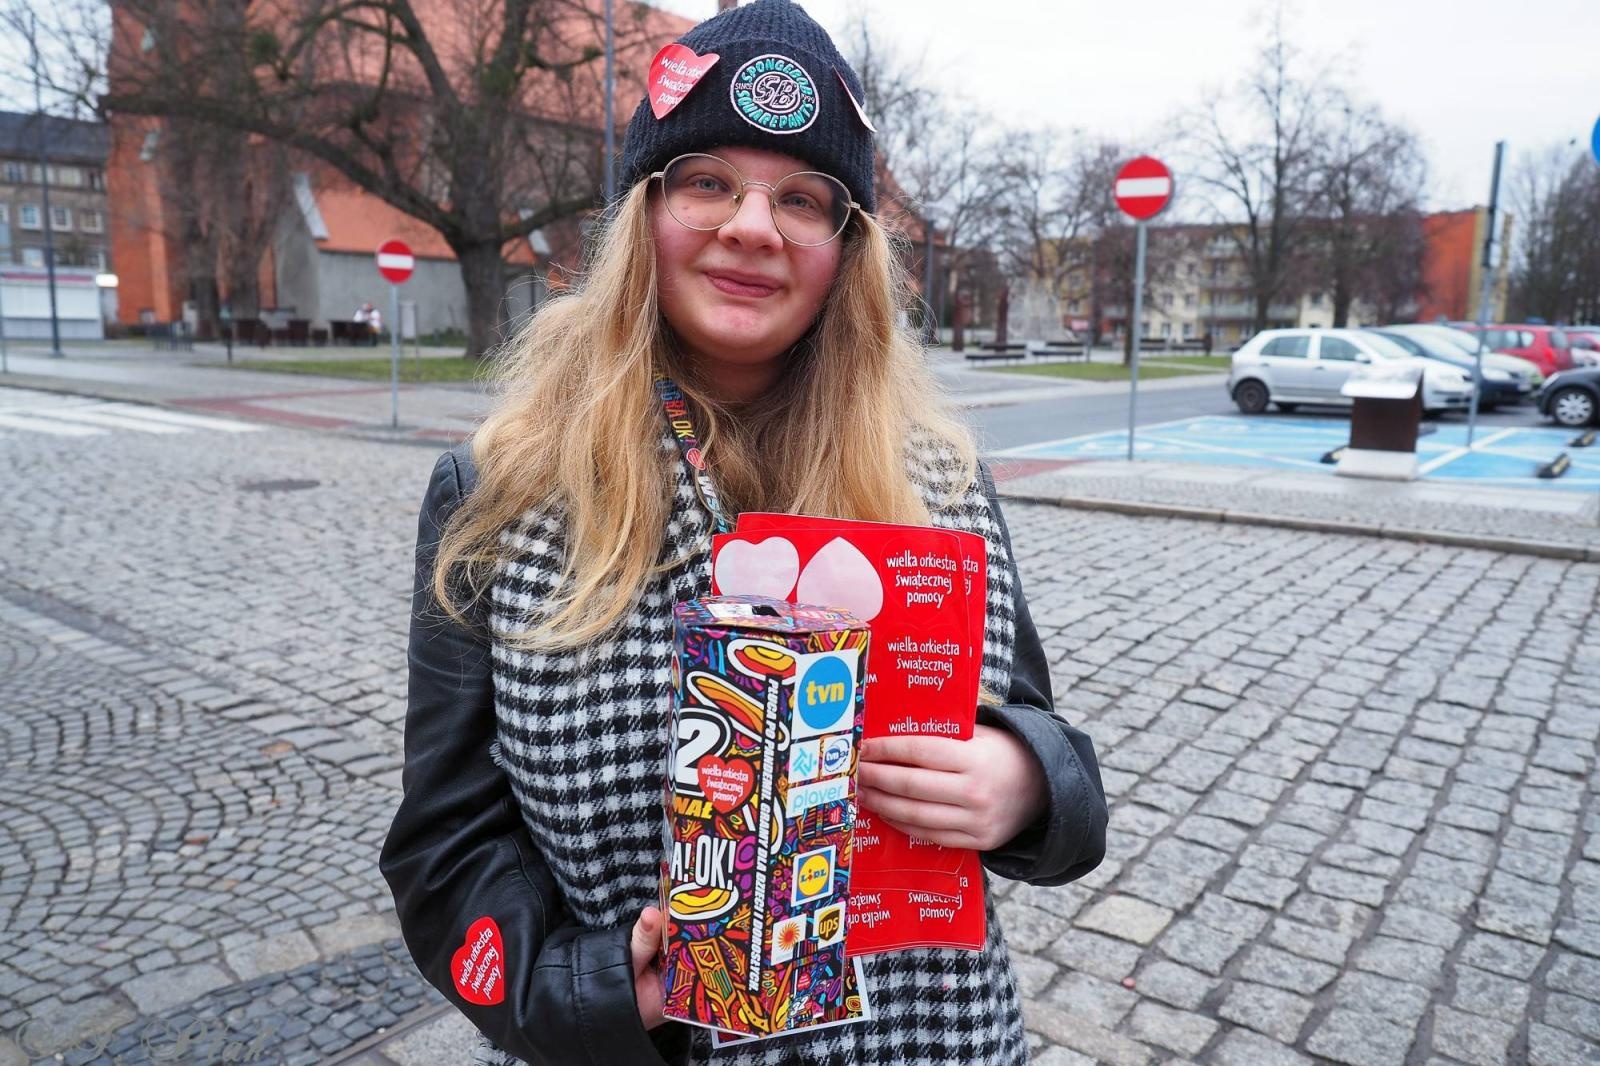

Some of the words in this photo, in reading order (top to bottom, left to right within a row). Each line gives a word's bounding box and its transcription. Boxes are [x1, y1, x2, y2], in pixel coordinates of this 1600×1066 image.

[741, 58, 813, 95] SPONGEBOB
[736, 89, 814, 128] SQUAREPANTS
[886, 550, 918, 568] wielka
[919, 554, 957, 572] orkiestra
[895, 570, 952, 594] świątecznej
[906, 591, 944, 609] pomocy
[887, 637, 918, 653] wielka
[920, 638, 960, 656] orkiestra
[896, 653, 953, 678] świątecznej
[806, 679, 845, 706] tvn
[908, 673, 944, 691] pomocy
[764, 719, 776, 740] PO
[888, 717, 919, 734] wielka
[920, 718, 960, 735] orkiestra
[701, 764, 722, 778] wielka
[722, 767, 749, 782] orkiestra
[712, 791, 738, 806] pomocy
[793, 785, 843, 812] player
[758, 802, 771, 849] GRAMY
[695, 835, 737, 890] OK!
[756, 846, 768, 872] DLA
[754, 871, 766, 912] DZIECI
[819, 917, 839, 938] ups
[862, 909, 891, 929] wielka
[919, 907, 955, 924] pomocy
[460, 958, 474, 987] wielka
[470, 927, 493, 962] orkiestra
[469, 942, 499, 994] świątecznej
[482, 964, 502, 1000] pomocy
